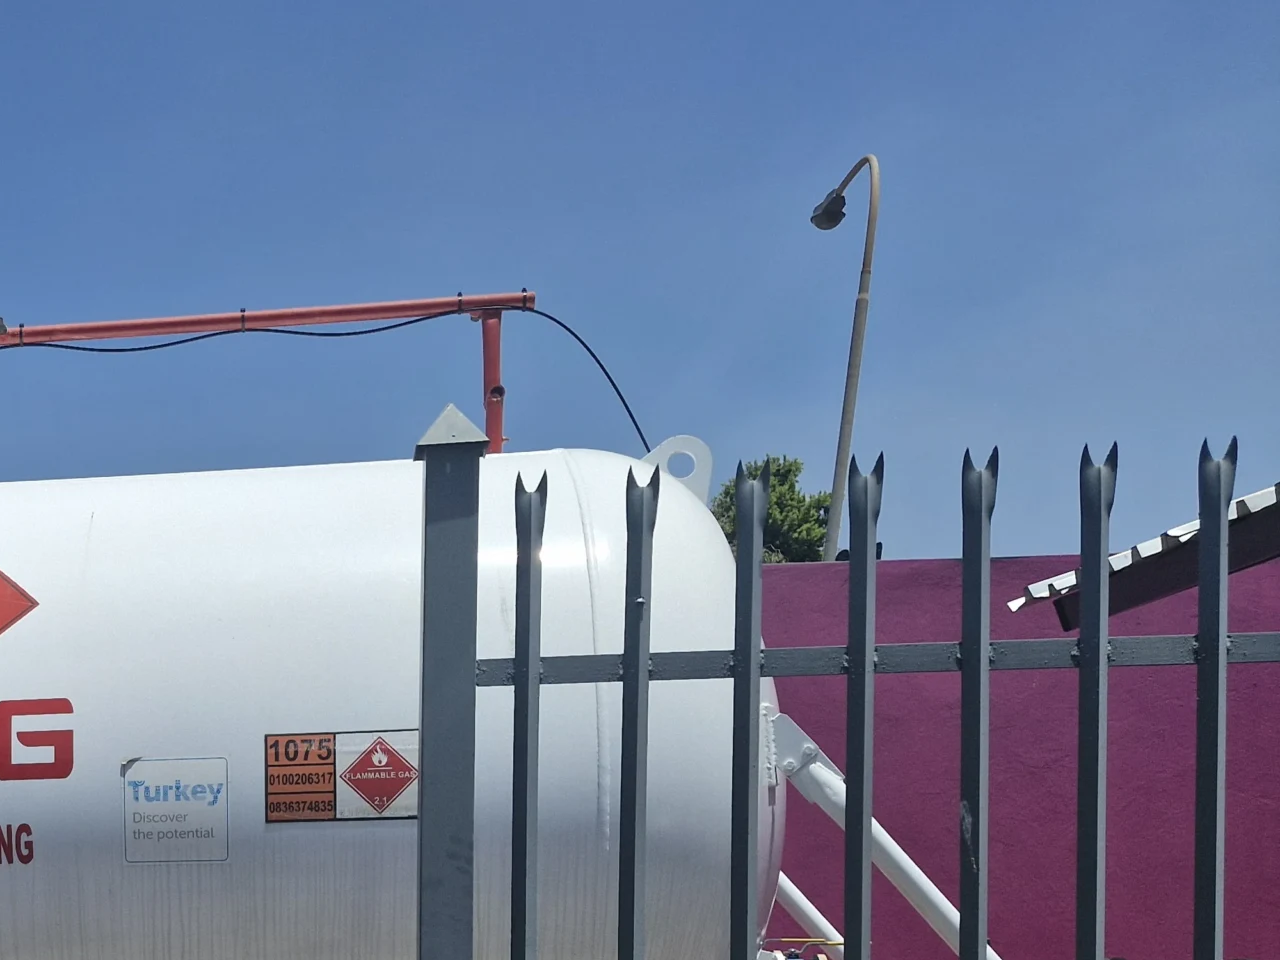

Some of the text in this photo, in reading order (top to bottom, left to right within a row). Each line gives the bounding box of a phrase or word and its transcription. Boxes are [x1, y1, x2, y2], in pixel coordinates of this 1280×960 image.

[269, 738, 332, 762] 1075
[269, 771, 333, 786] 0100206317
[346, 770, 416, 780] FLAMMABLE GAS
[127, 780, 224, 806] Turkey
[374, 796, 388, 805] 2.1
[269, 798, 334, 814] 0836374835
[132, 811, 188, 824] Discover
[132, 827, 214, 842] the potential
